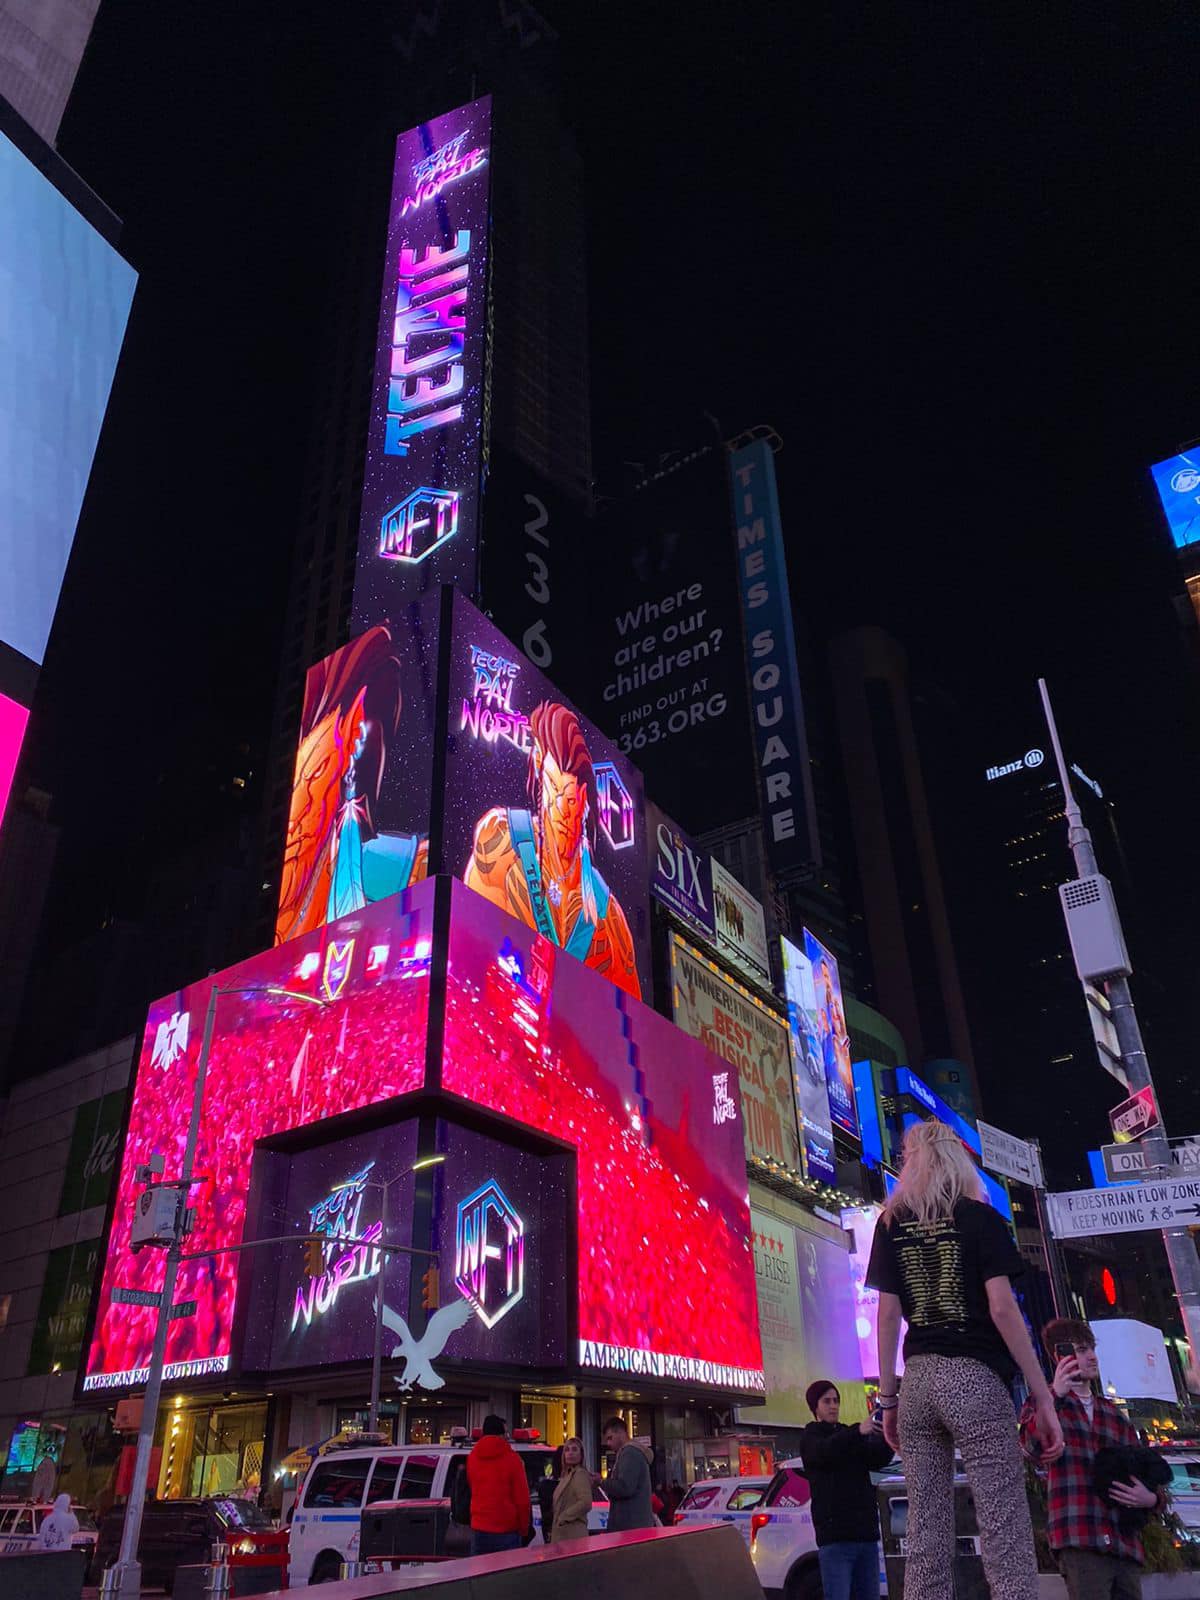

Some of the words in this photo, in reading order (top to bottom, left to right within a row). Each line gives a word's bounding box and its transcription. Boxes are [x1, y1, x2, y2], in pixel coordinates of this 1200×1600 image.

[401, 148, 486, 217] NORTE
[384, 230, 471, 456] TECATE
[386, 495, 453, 557] NFT
[736, 462, 768, 608] TIMES
[614, 635, 656, 666] are
[662, 609, 707, 643] our
[615, 583, 702, 636] Where
[470, 645, 520, 679] TECATE
[603, 628, 724, 701] children?
[461, 698, 533, 753] NORTE
[619, 693, 728, 754] 363.ORG
[620, 705, 652, 727] FIND
[656, 690, 687, 710] OUT
[691, 678, 709, 697] AT
[752, 630, 796, 843] SQUARE
[656, 823, 708, 912] SIX
[701, 1024, 769, 1096] MUSICAL
[714, 1008, 752, 1056] BEST
[1117, 1113, 1131, 1131] ONE
[1134, 1101, 1148, 1121] WAY
[1120, 1155, 1144, 1170] ON
[1067, 1190, 1135, 1212] PEDESTRIAN
[1138, 1188, 1167, 1204] FLOW
[1171, 1182, 1200, 1199] ZONE
[1072, 1213, 1098, 1230] KEEP
[1101, 1209, 1145, 1226] MOVING
[291, 1220, 390, 1332] NORTE
[461, 1192, 521, 1307] NFT
[764, 1254, 790, 1285] RISE
[85, 1370, 131, 1390] AMERICAN
[164, 1358, 226, 1380] OUTFITTERS
[584, 1342, 660, 1376] AMERICAN
[664, 1353, 700, 1382] EAGLE
[703, 1361, 767, 1392] OUTFITTERS
